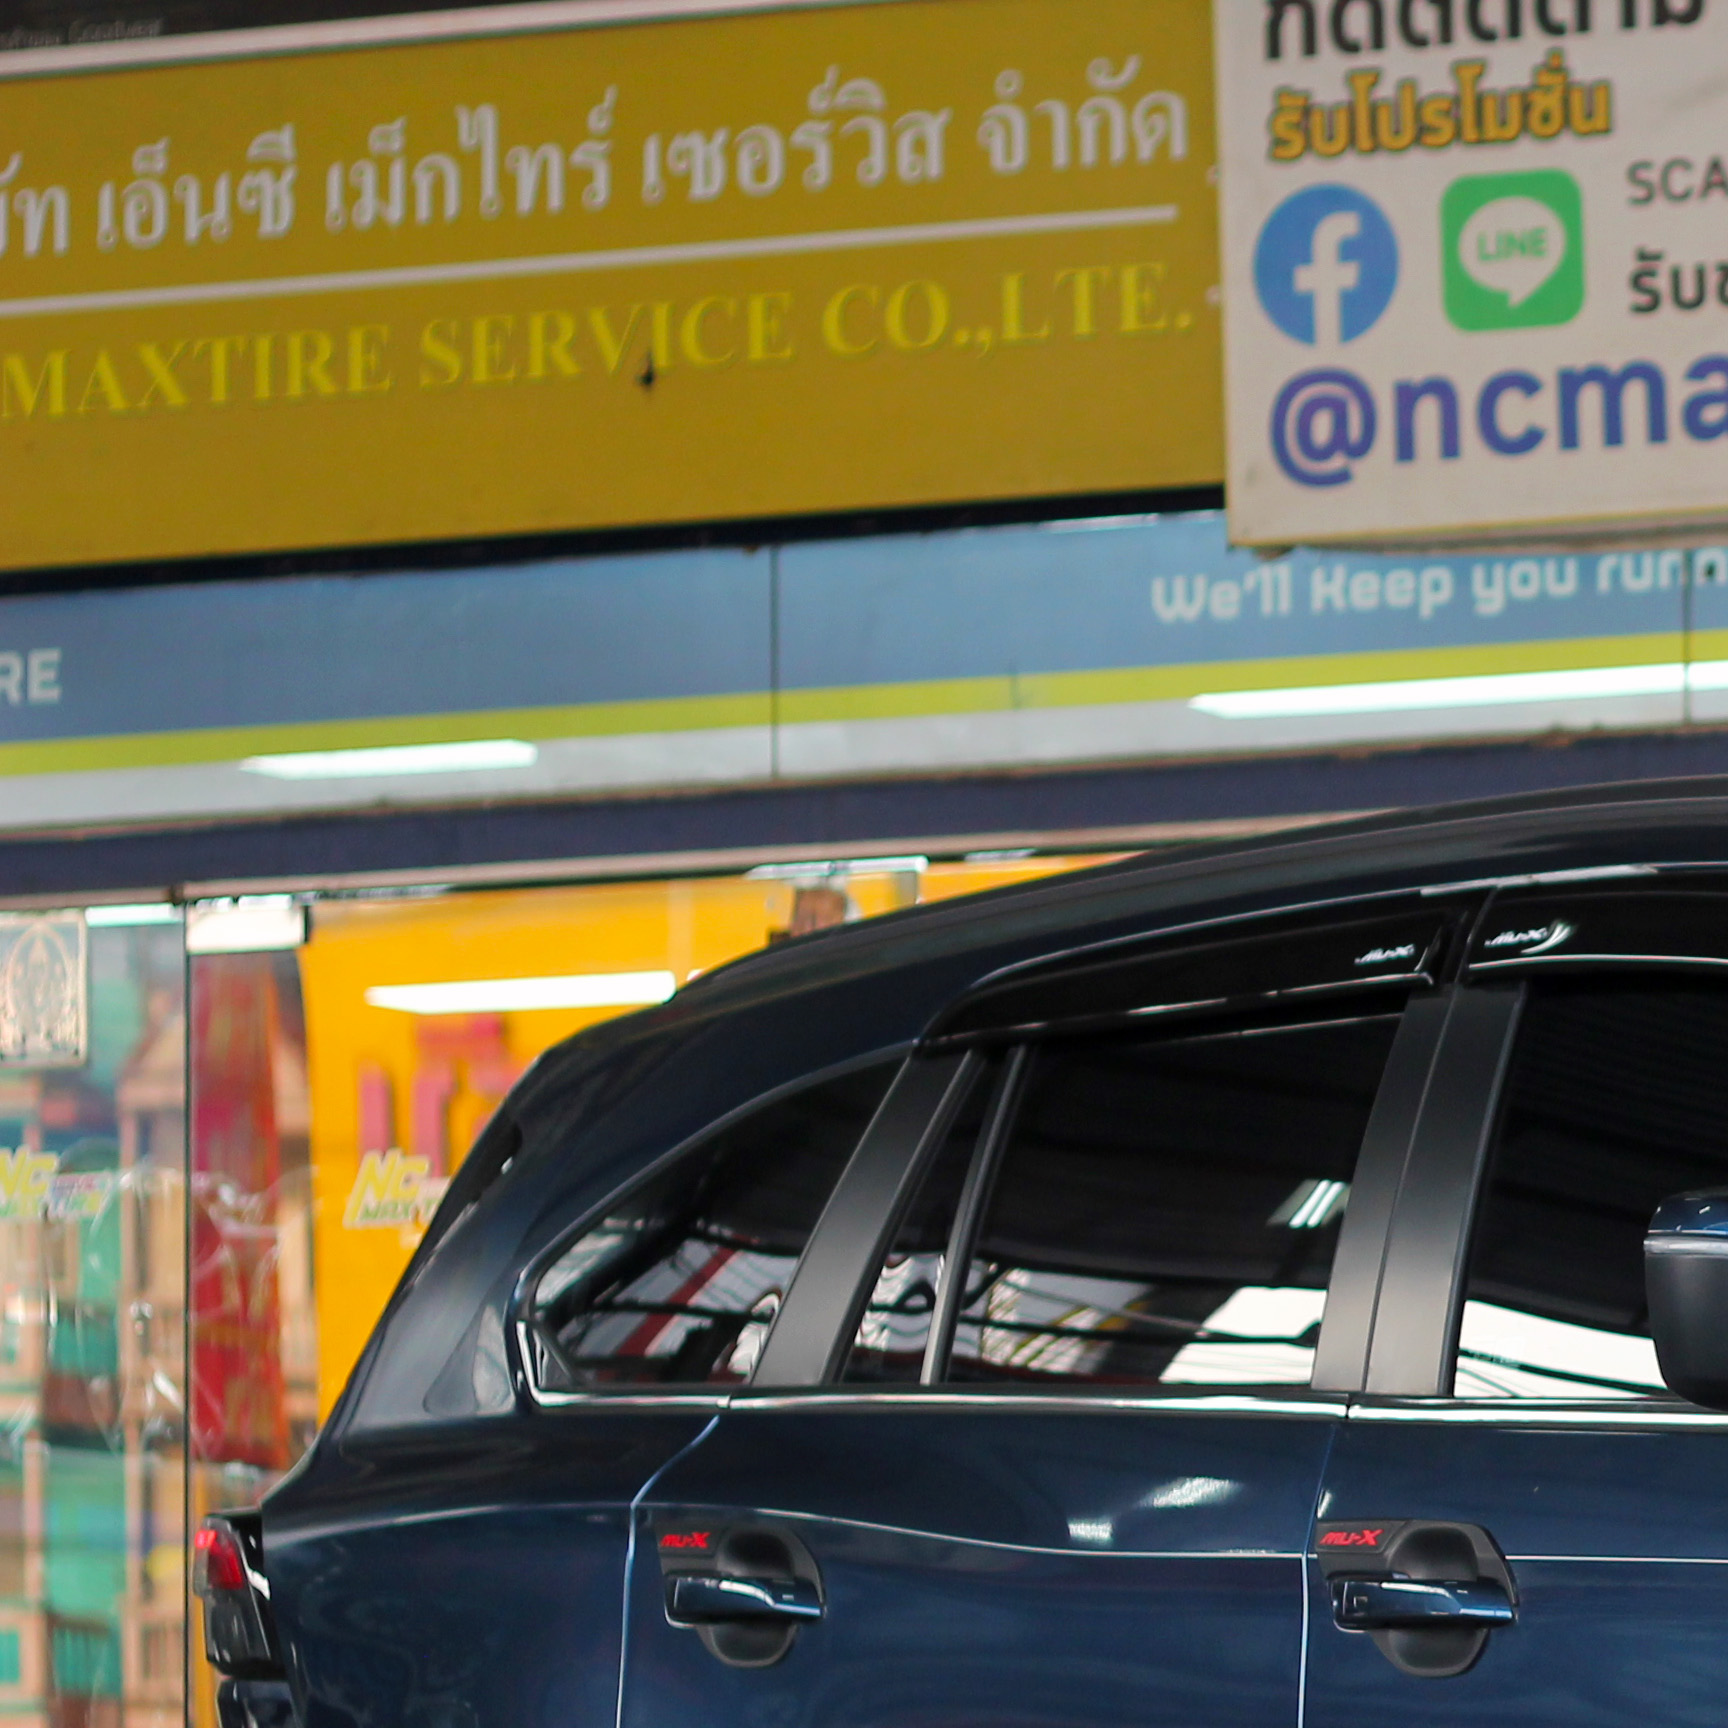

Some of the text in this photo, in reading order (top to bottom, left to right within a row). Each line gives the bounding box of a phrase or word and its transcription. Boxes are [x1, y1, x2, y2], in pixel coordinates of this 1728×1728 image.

[96, 126, 297, 250] เอ็นซี
[325, 88, 617, 232] เม็กไทร์
[642, 66, 949, 200] เซอร์วิส
[977, 56, 1190, 176] จำกัด
[1267, 49, 1613, 162] รับโปรโมชั่น
[1476, 227, 1549, 264] LINE
[1, 325, 394, 420] MAXTIRE
[420, 293, 794, 392] SERVICE
[1151, 562, 1293, 623] We'll
[1471, 556, 1578, 615] you
